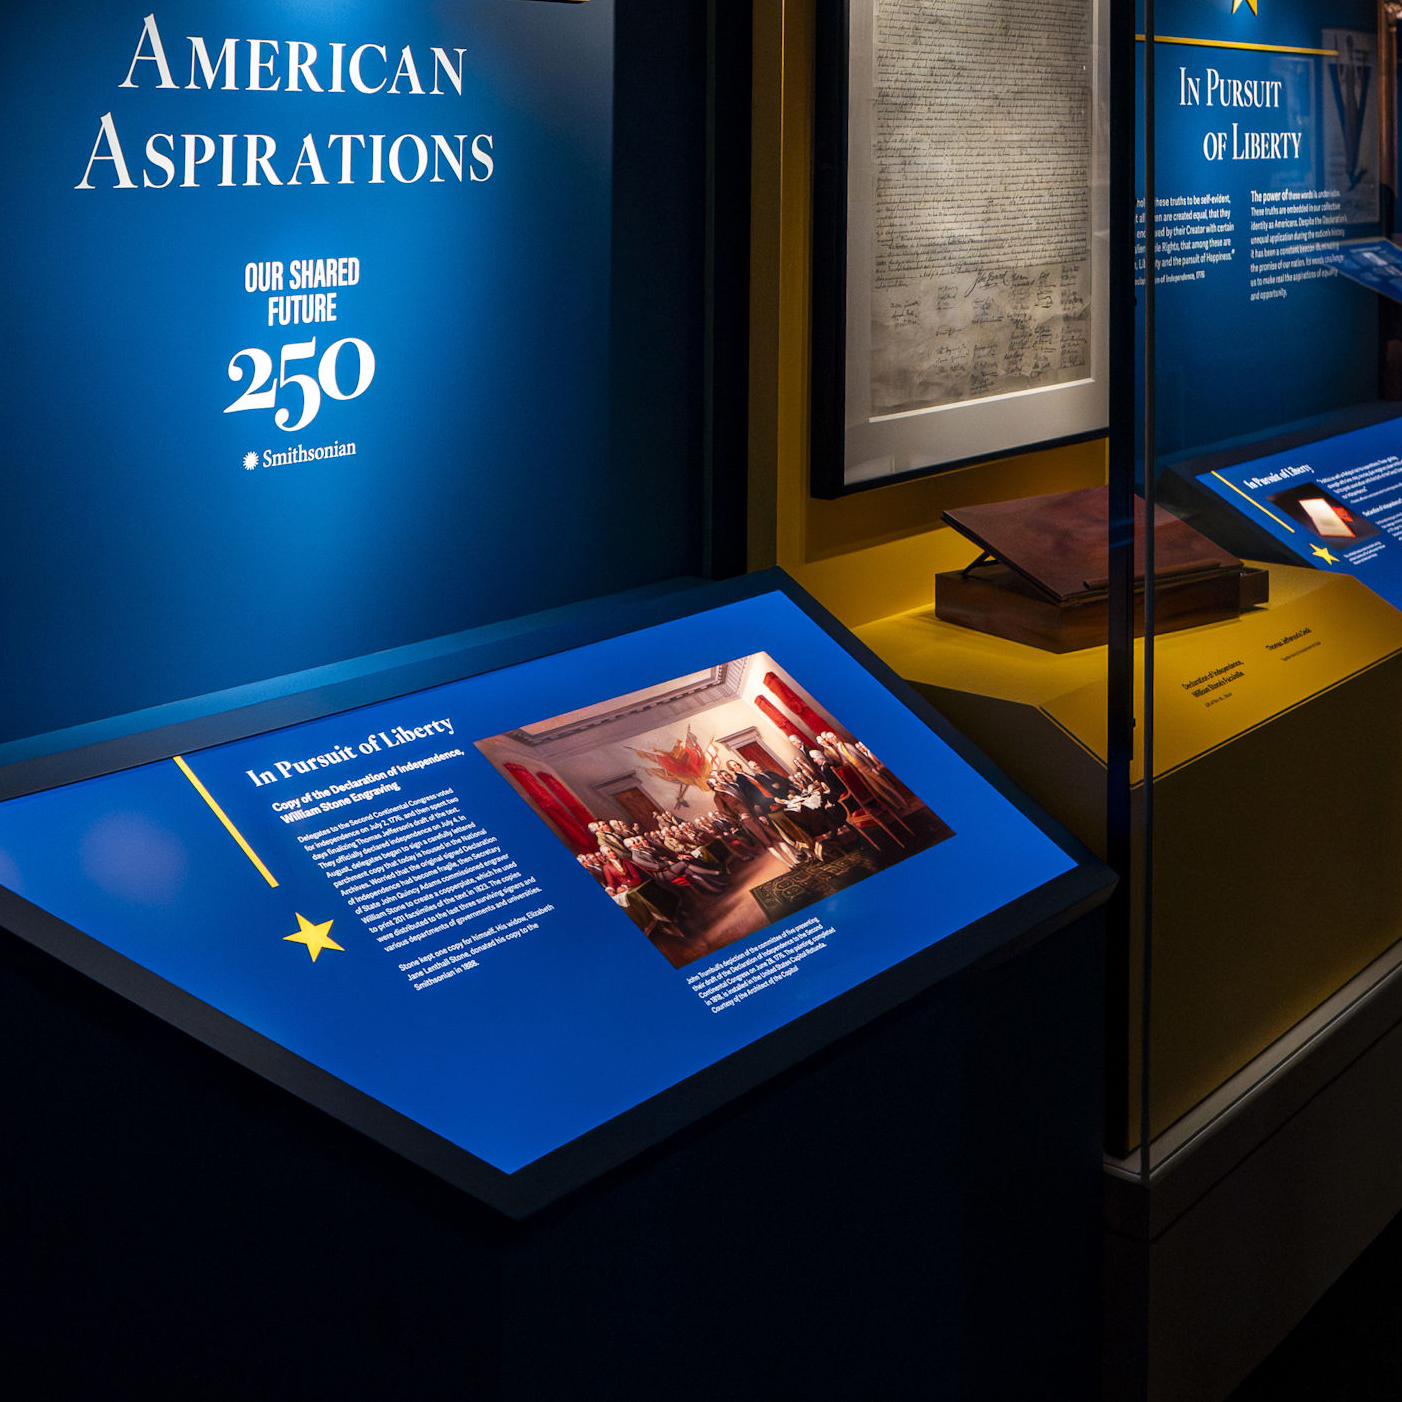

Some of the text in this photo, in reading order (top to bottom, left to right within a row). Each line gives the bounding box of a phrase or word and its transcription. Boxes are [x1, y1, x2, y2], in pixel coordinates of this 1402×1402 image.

[117, 13, 468, 96] AMERICAN
[1179, 66, 1282, 108] IN PURSUIT
[73, 111, 494, 190] ASPIRATIONS
[1232, 122, 1302, 160] LIBERTY
[1162, 213, 1172, 221] are
[1172, 209, 1192, 220] created
[1192, 208, 1207, 221] equal,
[1208, 208, 1219, 218] that
[1219, 207, 1230, 219] they
[1169, 195, 1186, 206] truths
[1186, 195, 1192, 205] to
[1192, 194, 1200, 205] be
[1200, 193, 1230, 204] self-evident,
[1250, 189, 1262, 202] The
[1165, 221, 1234, 238] by their Creator with certain
[244, 256, 361, 293] OUR SHARED
[267, 291, 338, 327] FUTURE
[222, 335, 376, 432] 250
[262, 440, 357, 468] Smithsonian
[245, 718, 454, 787] In Pursuit of Liberty
[271, 748, 464, 812] Copy of the Declaration of Independence,
[279, 781, 401, 823] William Stone Engraving
[296, 828, 331, 842] Delegates
[348, 813, 374, 826] Second
[372, 801, 409, 818] Continental
[407, 793, 437, 806] Congress
[435, 787, 454, 797] voted
[303, 843, 315, 851] for
[313, 829, 360, 848] independence
[368, 821, 383, 830] July
[387, 814, 404, 823] 1776,
[402, 809, 416, 819] and
[414, 806, 430, 814] then
[429, 800, 448, 810] spent
[445, 796, 459, 804] two
[311, 851, 328, 860] days
[326, 841, 358, 855] finalizing
[354, 833, 382, 845] Thomas
[381, 821, 414, 837] Jefferson's
[413, 816, 429, 826] draft
[444, 806, 460, 815] text.
[340, 836, 497, 896] Archives. Worried that the original signed Declaration
[361, 901, 381, 911] State
[380, 895, 397, 905] John
[395, 886, 420, 898] Quincy
[419, 878, 442, 890] Adams
[440, 861, 484, 882] commissioned
[483, 853, 509, 866] engraver
[360, 911, 387, 923] William
[385, 903, 406, 914] Stone
[413, 893, 434, 904] create
[438, 877, 476, 895] copperplate,
[474, 869, 494, 880] which
[501, 860, 517, 871] used
[413, 970, 455, 990] Smithsonian
[460, 959, 479, 970] 1888.
